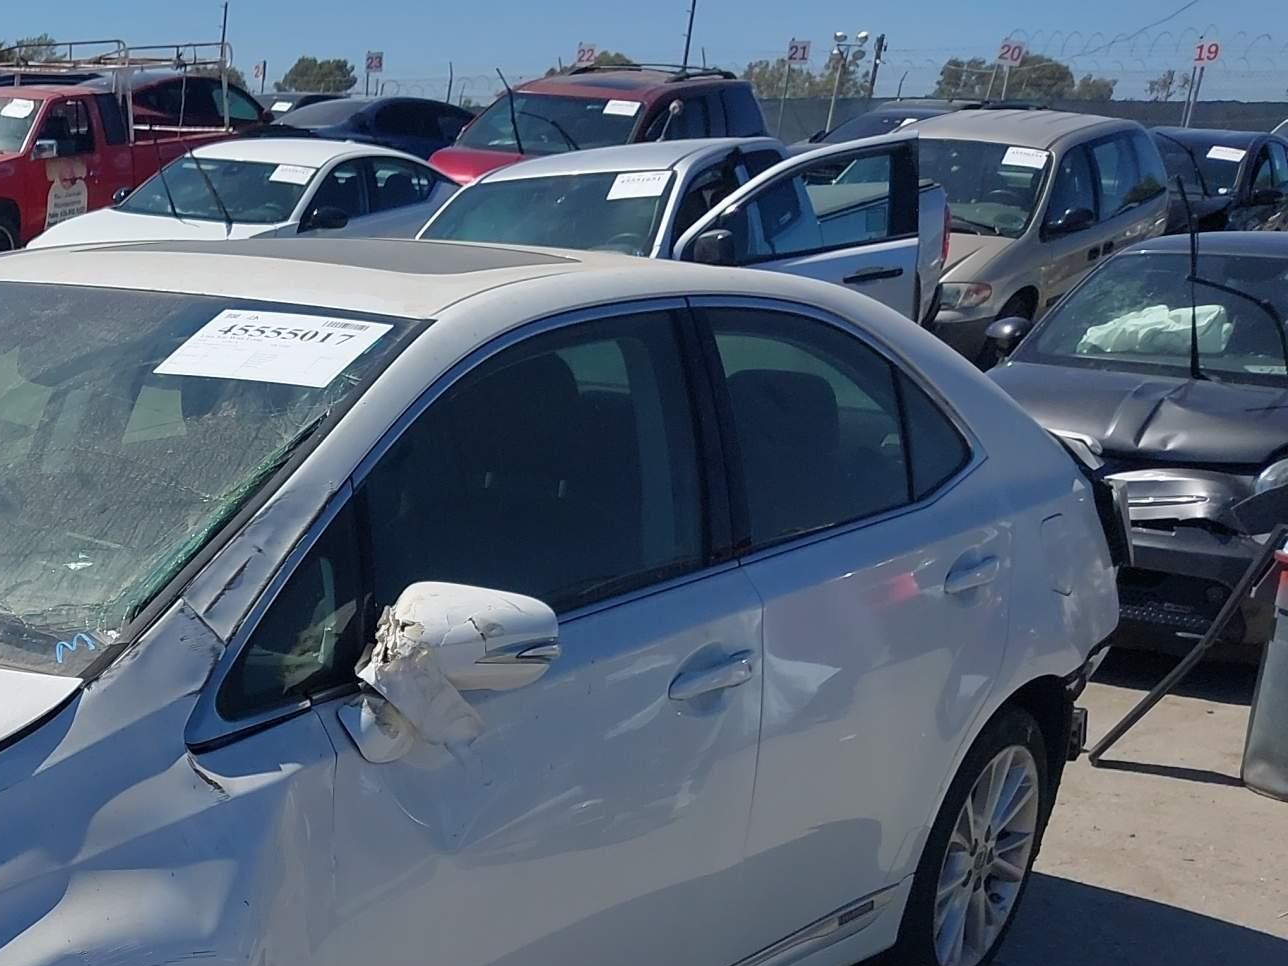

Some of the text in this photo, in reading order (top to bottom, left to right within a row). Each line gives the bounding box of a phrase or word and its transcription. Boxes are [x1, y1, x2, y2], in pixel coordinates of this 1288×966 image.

[577, 48, 595, 63] 22
[788, 45, 808, 61] 21
[998, 44, 1022, 62] 20
[1194, 43, 1219, 61] 19
[366, 55, 383, 70] 23
[218, 323, 357, 346] 45555017
